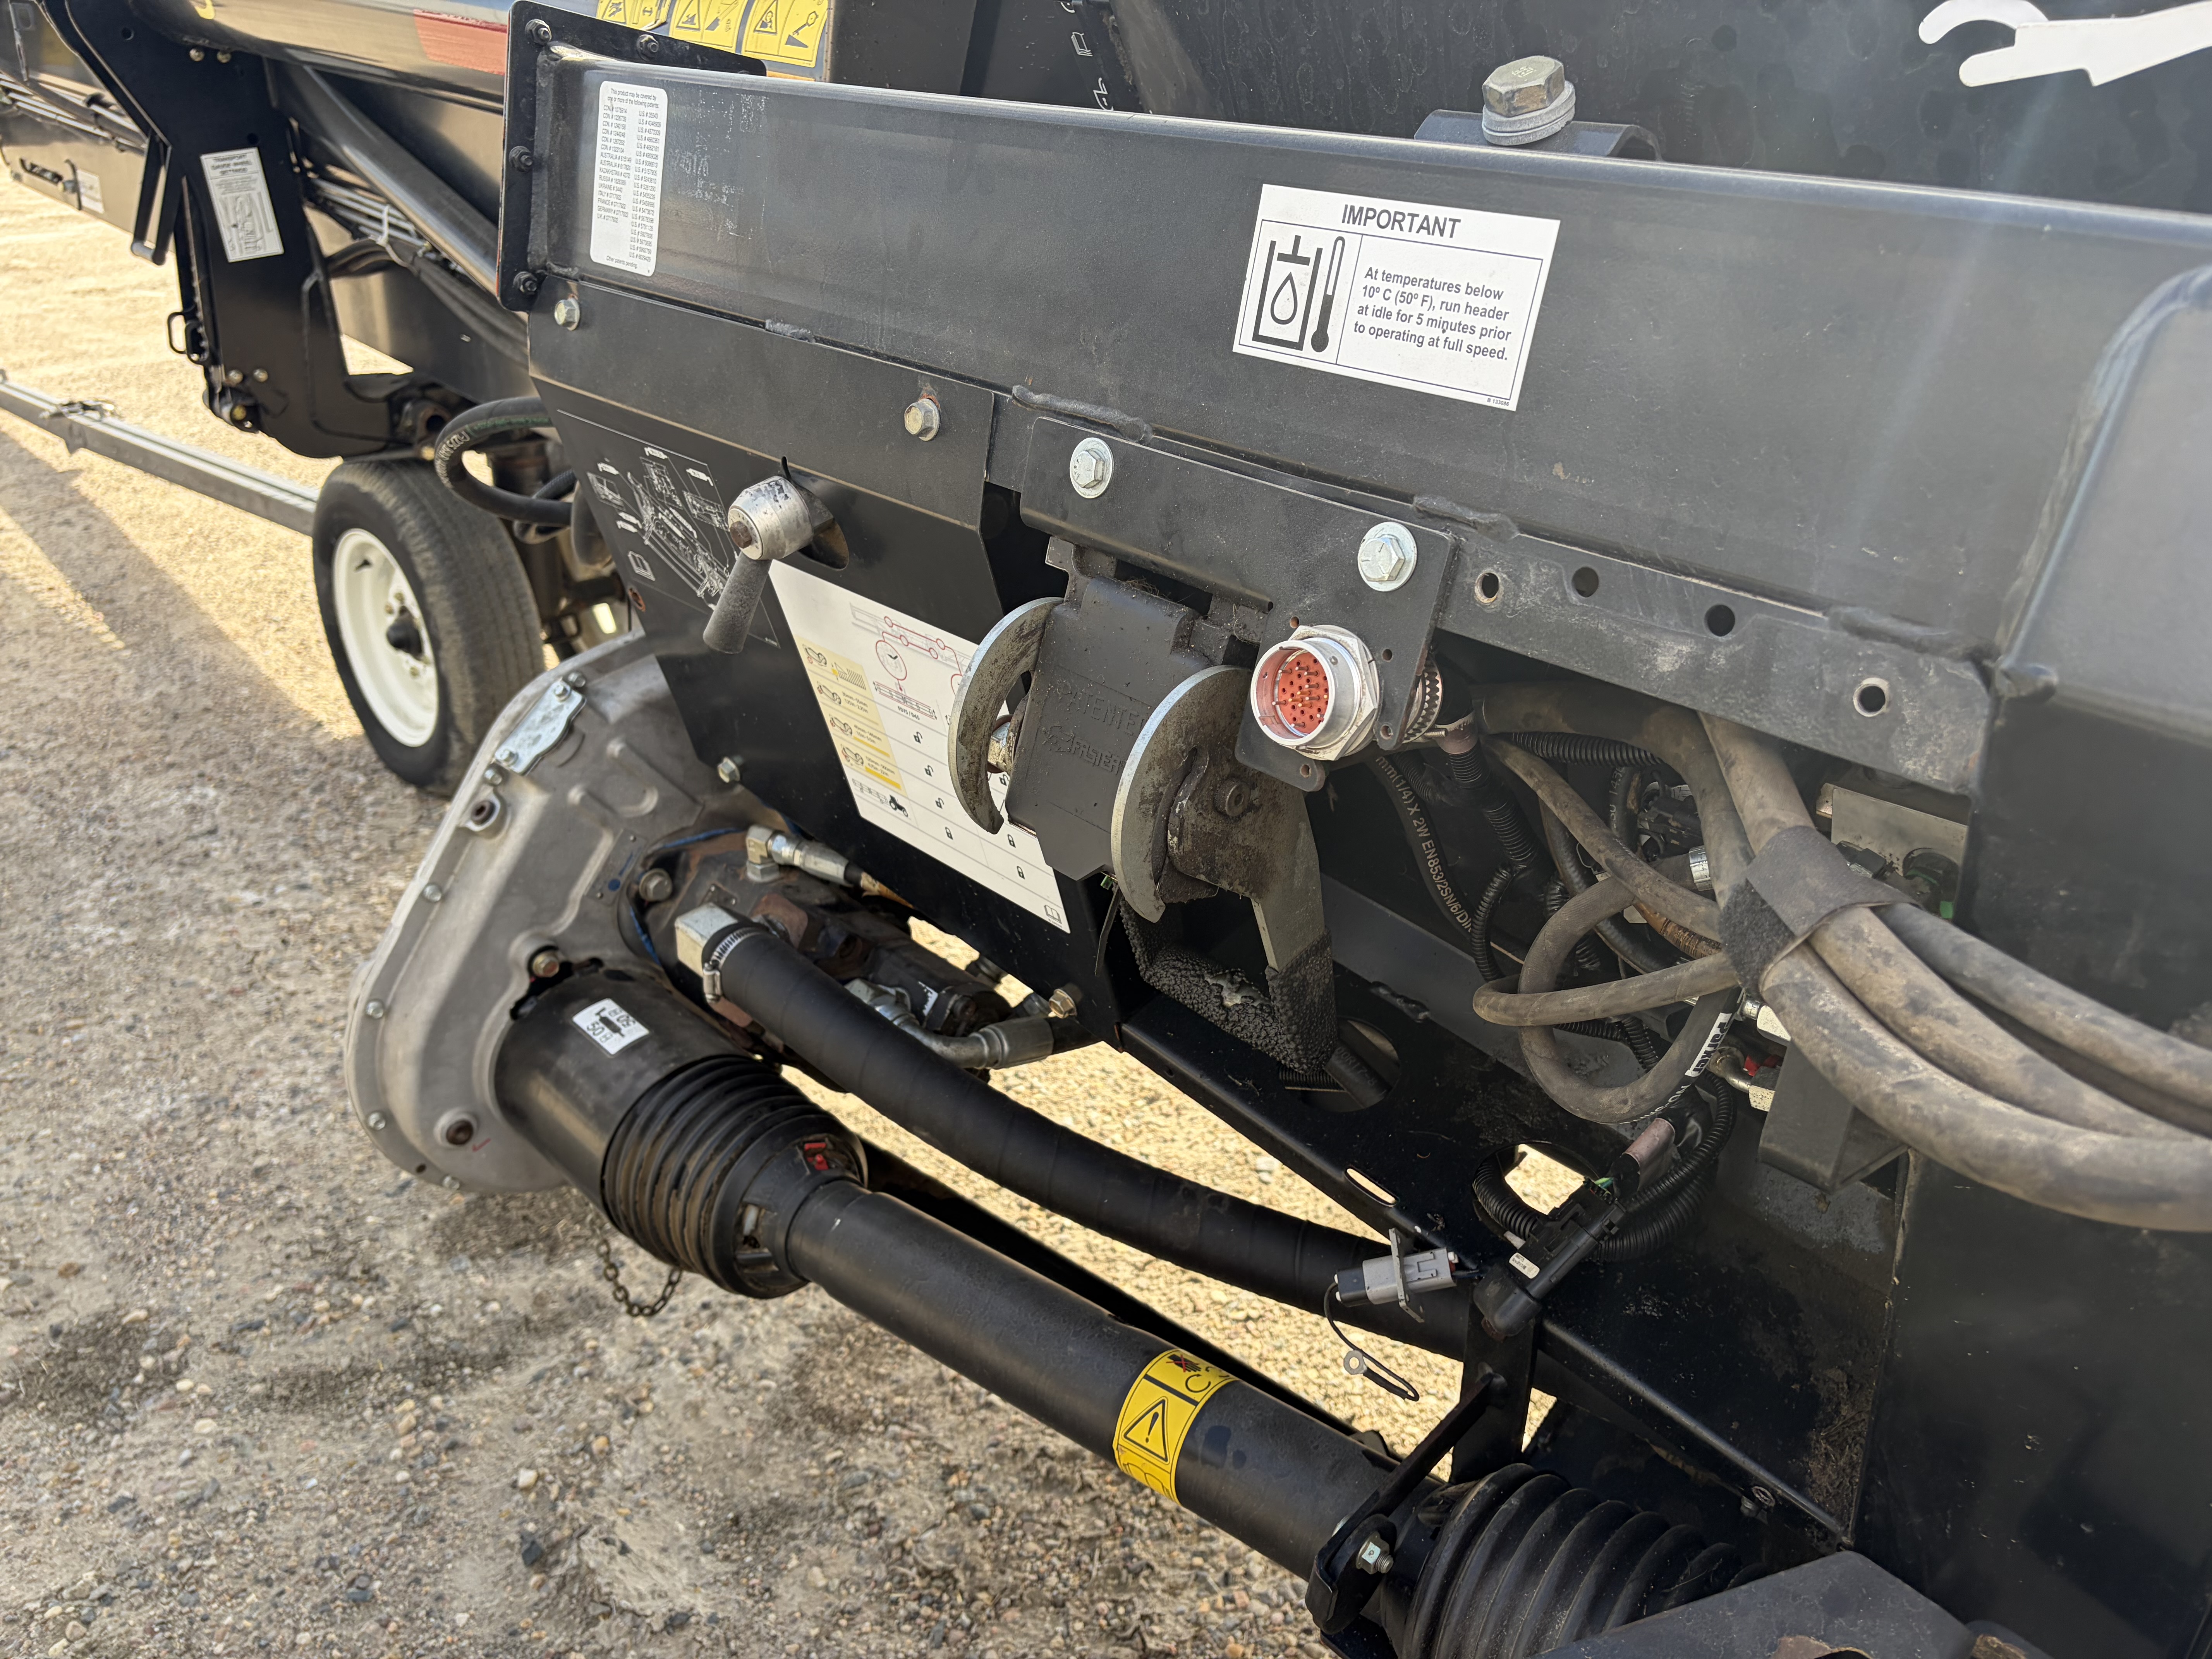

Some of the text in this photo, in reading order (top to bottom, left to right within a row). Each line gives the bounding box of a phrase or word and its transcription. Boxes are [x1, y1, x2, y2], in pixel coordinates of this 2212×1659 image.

[1342, 204, 1461, 238] IMPORTANT
[1364, 267, 1504, 300] At temperatures below
[1383, 289, 1391, 301] C
[1421, 295, 1435, 311] F),
[1440, 301, 1460, 313] run
[1464, 302, 1510, 320] header
[1357, 304, 1511, 340] at idle for 5 minutes prior
[1354, 321, 1507, 360] to operating at full speed.
[1058, 682, 1145, 736] PATENTE
[1407, 803, 1420, 816] X
[1413, 817, 1430, 837] 2W
[1692, 1013, 1733, 1074] Parker
